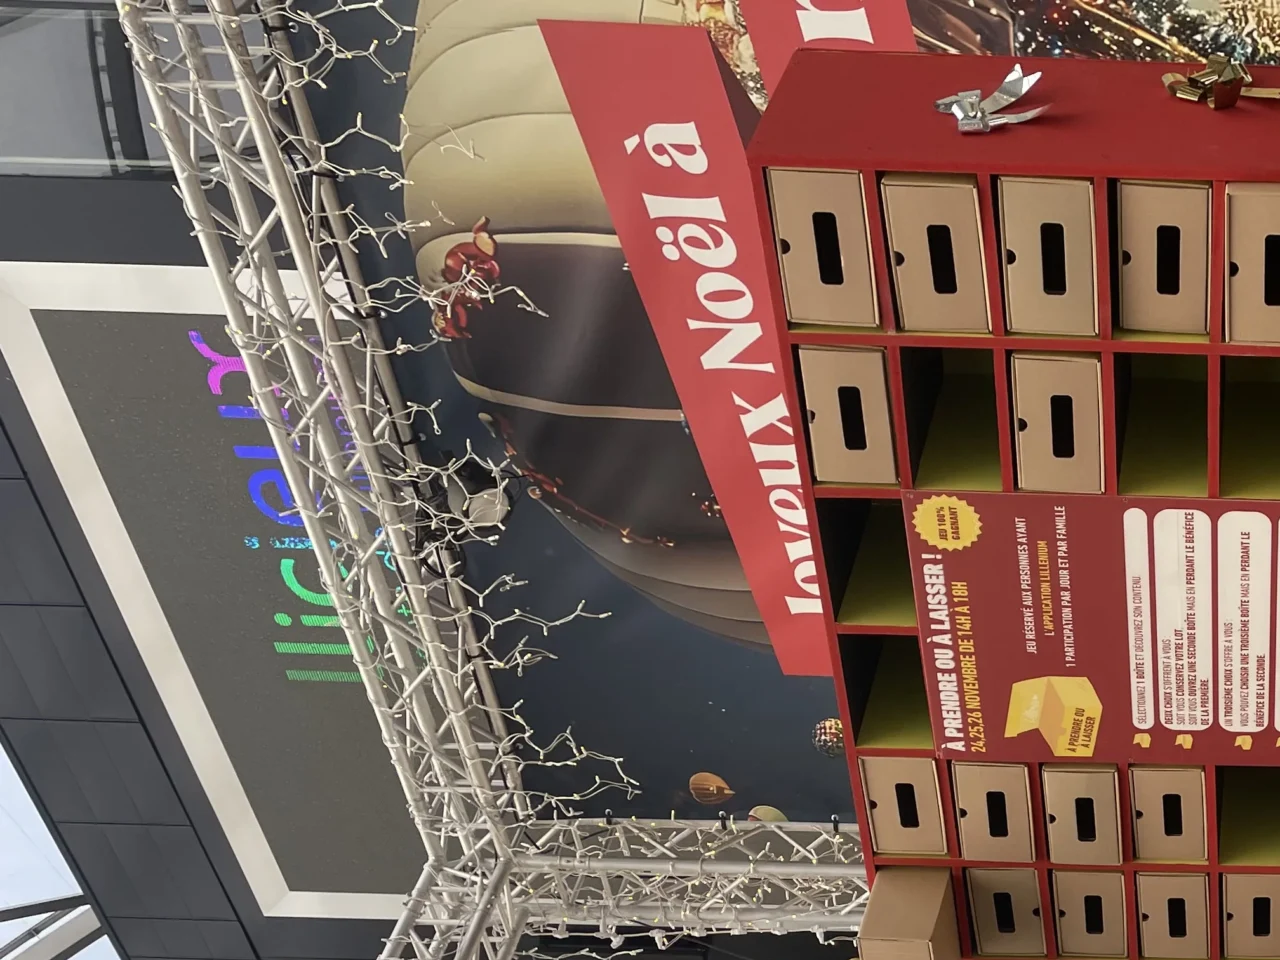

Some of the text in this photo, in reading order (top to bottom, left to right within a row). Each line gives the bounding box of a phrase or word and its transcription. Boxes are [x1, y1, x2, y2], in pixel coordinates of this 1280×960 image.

[624, 121, 708, 174] à
[642, 192, 775, 374] Noël
[936, 507, 948, 541] JEU 100%
[949, 506, 960, 540] GAGNANT
[1054, 506, 1067, 539] FAMILLE
[1182, 512, 1194, 544] BÉNÉFICE
[1057, 541, 1068, 556] PAR
[1185, 545, 1194, 553] LE
[1241, 542, 1250, 571] PERDANT
[1058, 558, 1069, 567] ET
[1186, 555, 1194, 585] PERDANT
[1015, 517, 1037, 654] JEU RÉSERVÉ AUX PERSONNES AYANT
[1037, 541, 1054, 635] L'APPLICATION LILLENIUM
[1059, 570, 1070, 589] JOUR
[923, 564, 950, 629] LAISSER
[951, 582, 968, 602] 18H
[1060, 591, 1072, 606] PAR
[1240, 583, 1249, 597] MAIS
[1134, 606, 1142, 617] SON
[1186, 596, 1195, 610] MAIS
[1238, 600, 1249, 617] BOÎTE
[955, 616, 972, 636] 14H
[1184, 613, 1195, 630] BOÎTE
[1224, 623, 1232, 637] VOUS
[927, 634, 952, 645] À
[1062, 608, 1075, 661] PARTICIPATION
[1133, 620, 1143, 652] DÉCOUVREZ
[1238, 620, 1249, 651] TROISIÈME
[958, 639, 974, 652] DE
[1162, 639, 1171, 654] VOUS
[1175, 642, 1184, 661] VOTRE
[1187, 633, 1196, 659] SECONDE
[934, 649, 955, 669] OU
[1224, 645, 1233, 667] S'OFFRE
[1240, 653, 1249, 665] UNE
[1133, 662, 1144, 679] BOÎTE
[1163, 661, 1172, 690] S'OFFRENT
[1188, 661, 1196, 672] UNE
[960, 655, 981, 709] NOVEMBRE
[1175, 663, 1184, 696] CONSERVEZ
[1188, 675, 1196, 696] OUVREZ
[1224, 669, 1233, 686] CHOIX
[1240, 667, 1249, 690] CHOISIR
[937, 673, 963, 737] PRENDRE
[1136, 686, 1146, 724] SÉLECTIONNEZ
[1164, 692, 1172, 708] CHOIX
[1176, 698, 1185, 711] VOUS
[1188, 698, 1197, 712] VOUS
[1222, 688, 1233, 717] TROISIÈME
[1240, 691, 1249, 711] POUVEZ
[1075, 708, 1085, 717] OU
[1165, 710, 1173, 724] DEUX
[1176, 713, 1185, 725] SOIT
[1189, 713, 1197, 725] SOIT
[1240, 713, 1249, 726] VOUS
[1254, 701, 1264, 727] BÉNÉFICE
[967, 712, 986, 752] 24,25,26
[1068, 718, 1083, 746] PRENDRE
[1082, 717, 1096, 742] LAISSER
[942, 741, 965, 751] À
